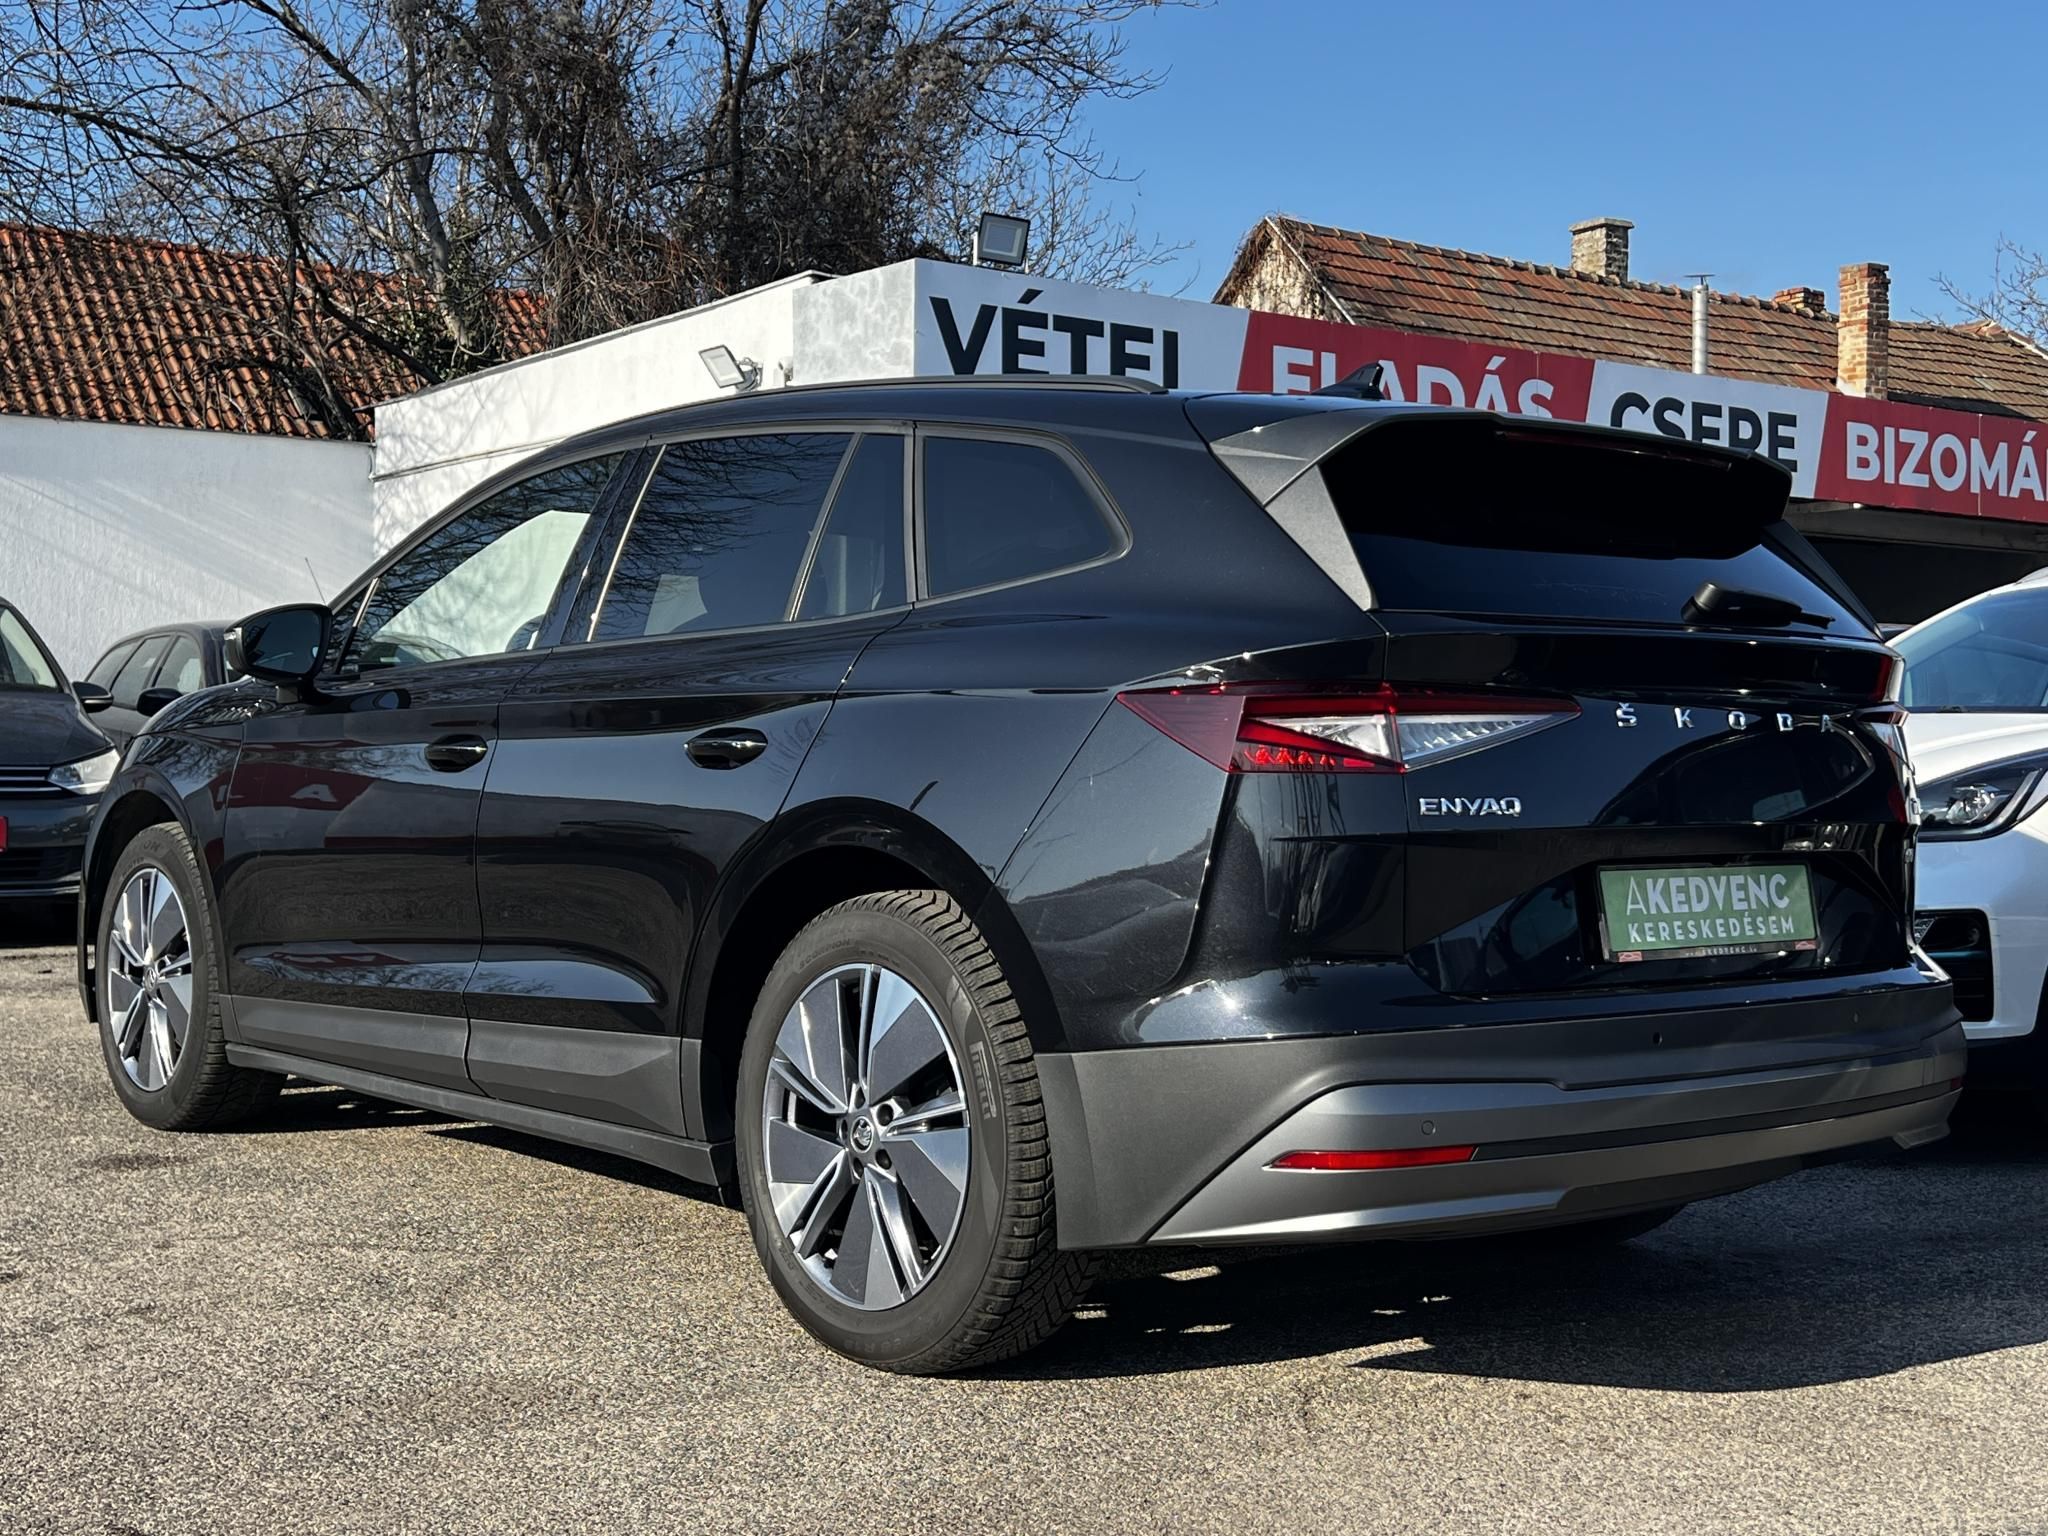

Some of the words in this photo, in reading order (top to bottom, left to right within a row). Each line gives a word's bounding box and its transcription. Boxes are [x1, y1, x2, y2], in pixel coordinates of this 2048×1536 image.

[1846, 422, 2048, 502] BIZOMÁ
[1615, 702, 1834, 733] ŠKODA
[1419, 797, 1522, 817] ENYAQ
[1627, 912, 1795, 943] KERESKEDÉSEM
[968, 1040, 998, 1121] PIRELLI
